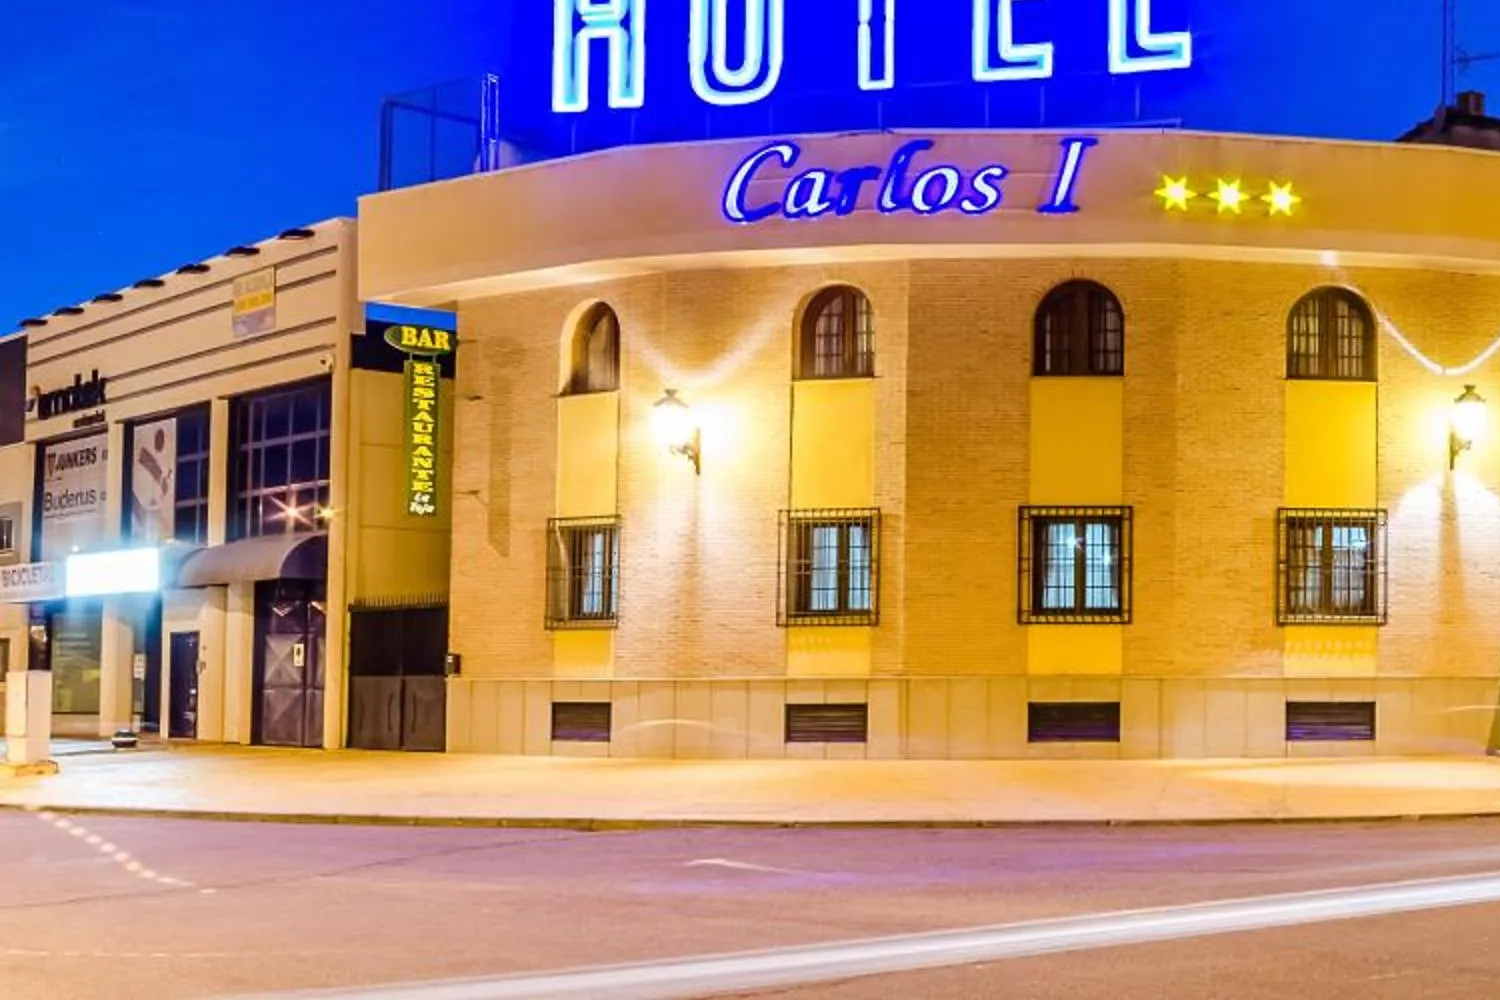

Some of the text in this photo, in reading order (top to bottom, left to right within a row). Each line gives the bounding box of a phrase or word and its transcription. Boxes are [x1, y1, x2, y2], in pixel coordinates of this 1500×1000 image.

[720, 135, 1101, 224] Carlos I
[401, 326, 451, 350] BAR
[411, 362, 435, 492] RESTAURANTE
